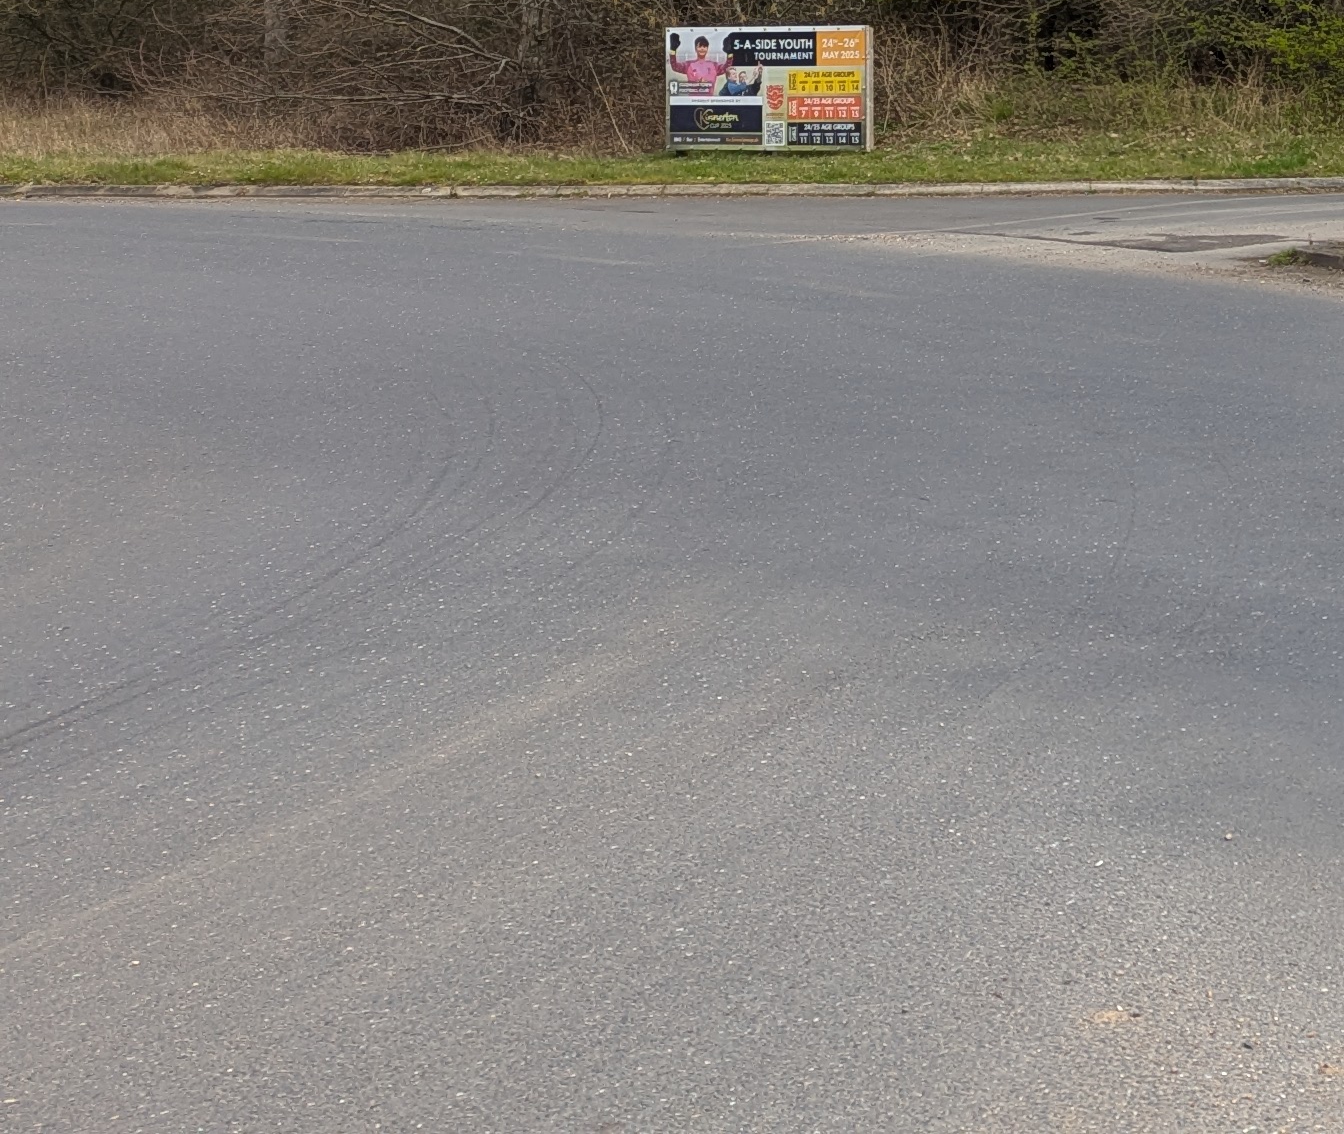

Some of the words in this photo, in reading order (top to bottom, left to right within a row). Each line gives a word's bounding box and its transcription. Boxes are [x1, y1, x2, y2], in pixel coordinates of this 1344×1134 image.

[733, 38, 777, 50] 5-A-SIDE
[778, 38, 813, 50] YOUTH
[754, 52, 814, 60] TOURNAMENT
[822, 51, 838, 59] MAY
[840, 51, 860, 59] 2025
